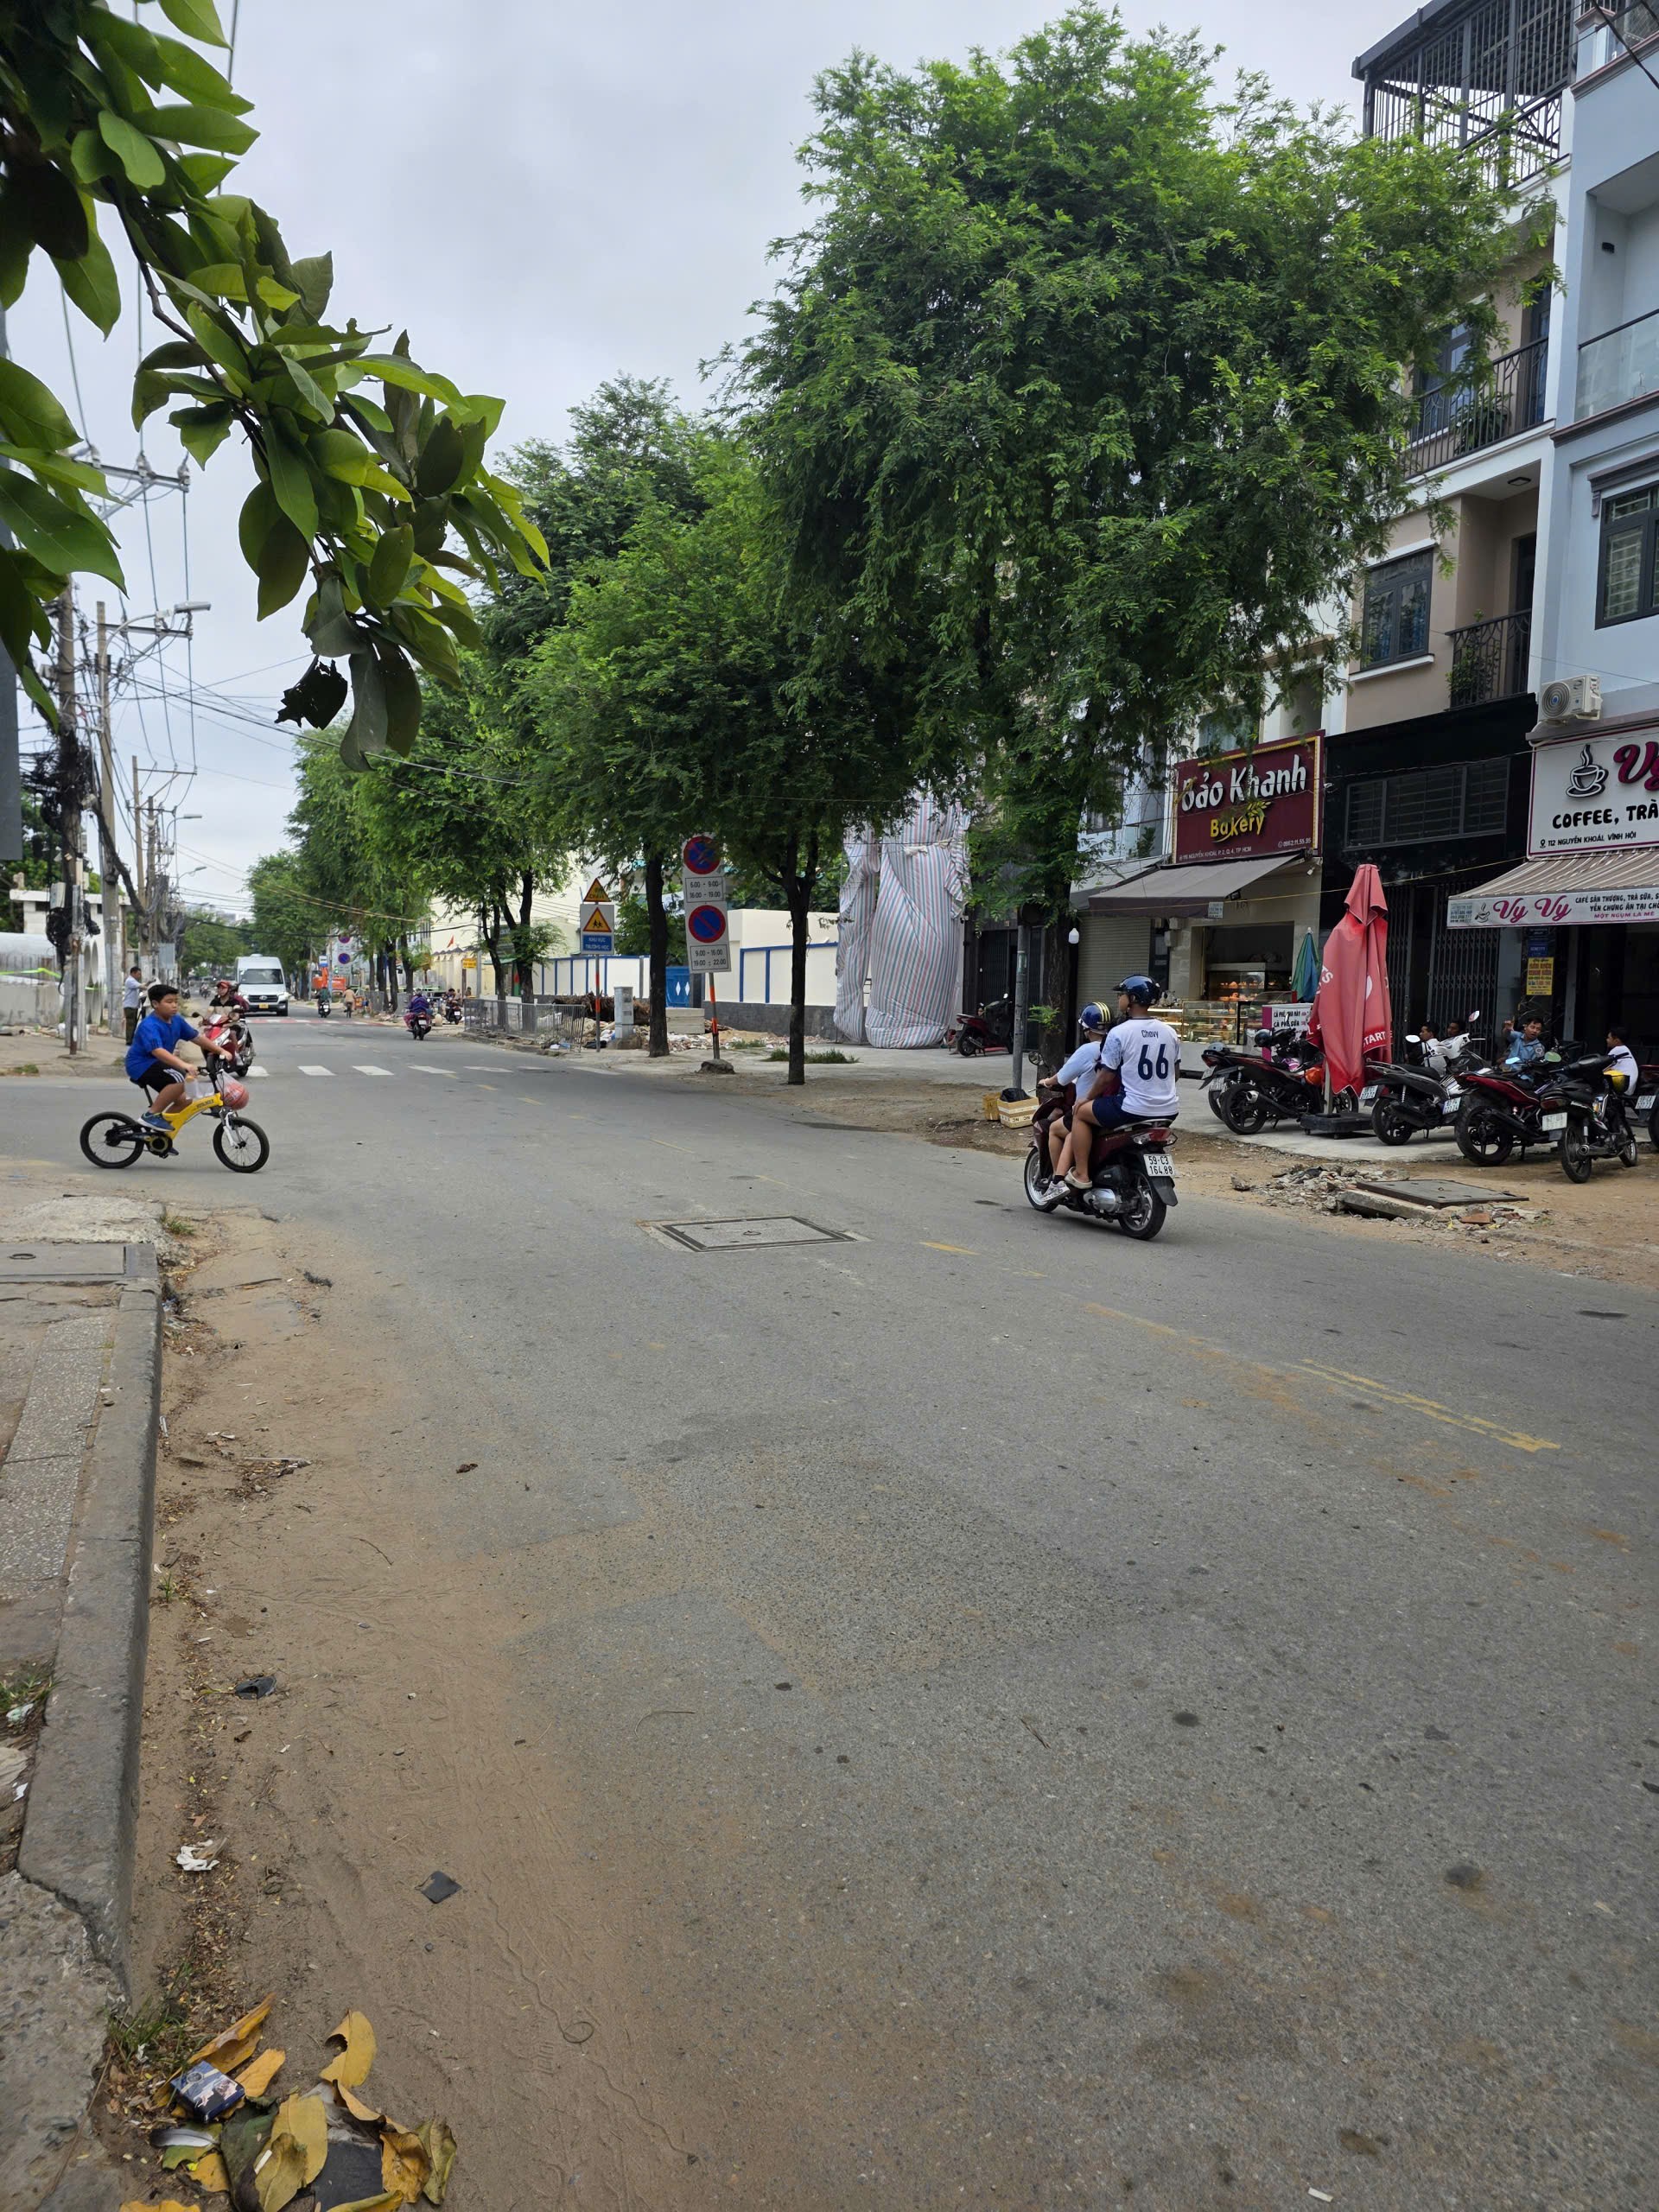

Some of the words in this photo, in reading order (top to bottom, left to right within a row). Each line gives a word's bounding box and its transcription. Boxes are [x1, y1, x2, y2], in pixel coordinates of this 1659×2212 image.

[1230, 754, 1306, 803] Khanh
[1210, 812, 1266, 837] Bakery
[1552, 809, 1619, 830] COFFEE,
[1626, 798, 1658, 821] TRÀ
[1493, 898, 1529, 924] Vy
[1534, 895, 1572, 922] Vy
[1137, 1043, 1169, 1081] 66
